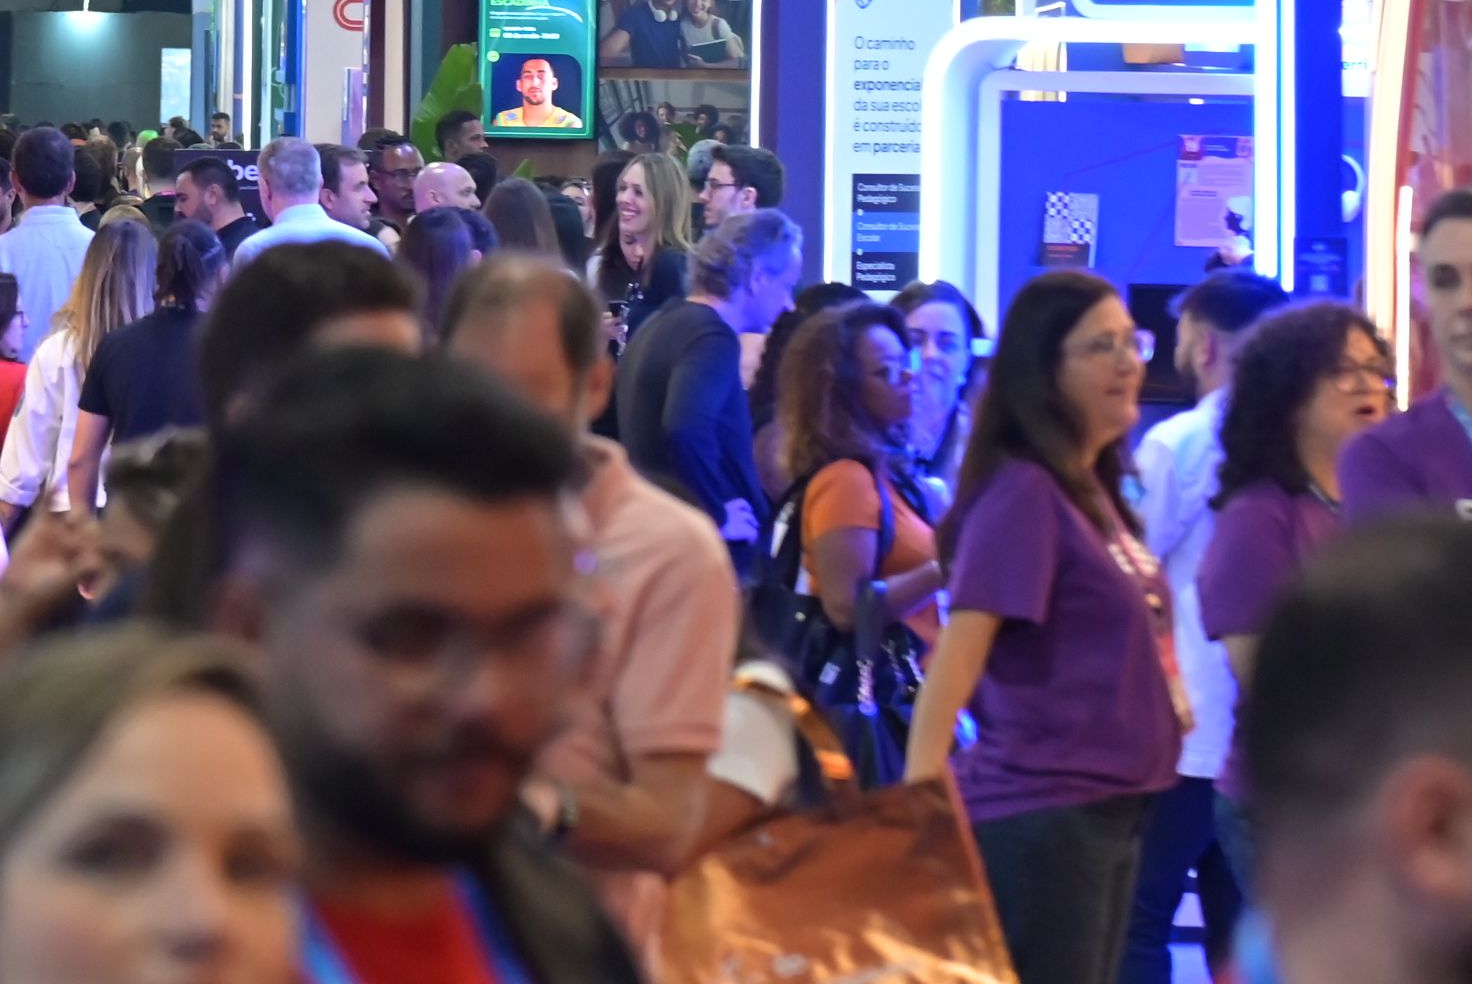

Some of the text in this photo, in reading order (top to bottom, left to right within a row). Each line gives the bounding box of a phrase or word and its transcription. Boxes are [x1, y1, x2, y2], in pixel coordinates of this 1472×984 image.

[854, 35, 915, 50] O caminho
[854, 60, 879, 73] para
